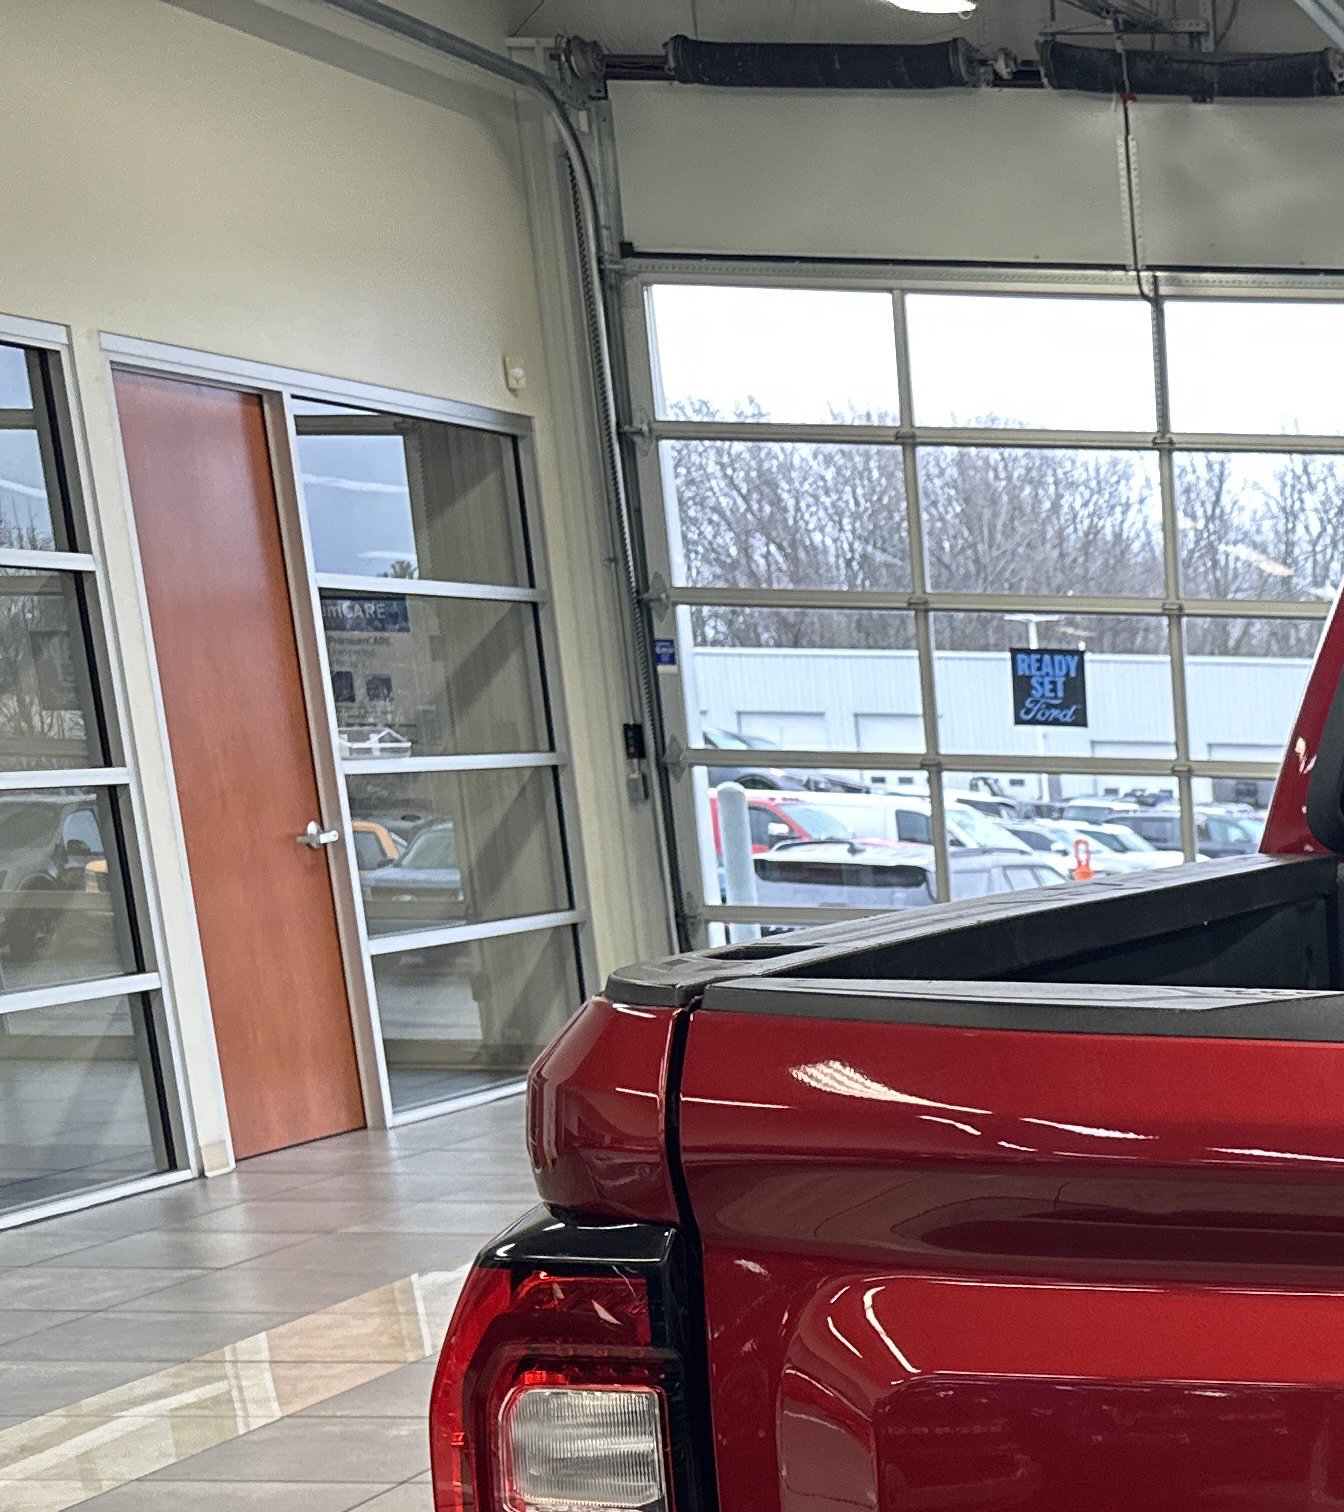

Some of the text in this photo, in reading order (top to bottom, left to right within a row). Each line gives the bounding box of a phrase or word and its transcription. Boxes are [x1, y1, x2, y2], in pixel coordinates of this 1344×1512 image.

[1016, 653, 1078, 677] READY
[1030, 676, 1066, 698] SET
[1020, 698, 1081, 722] Ford
